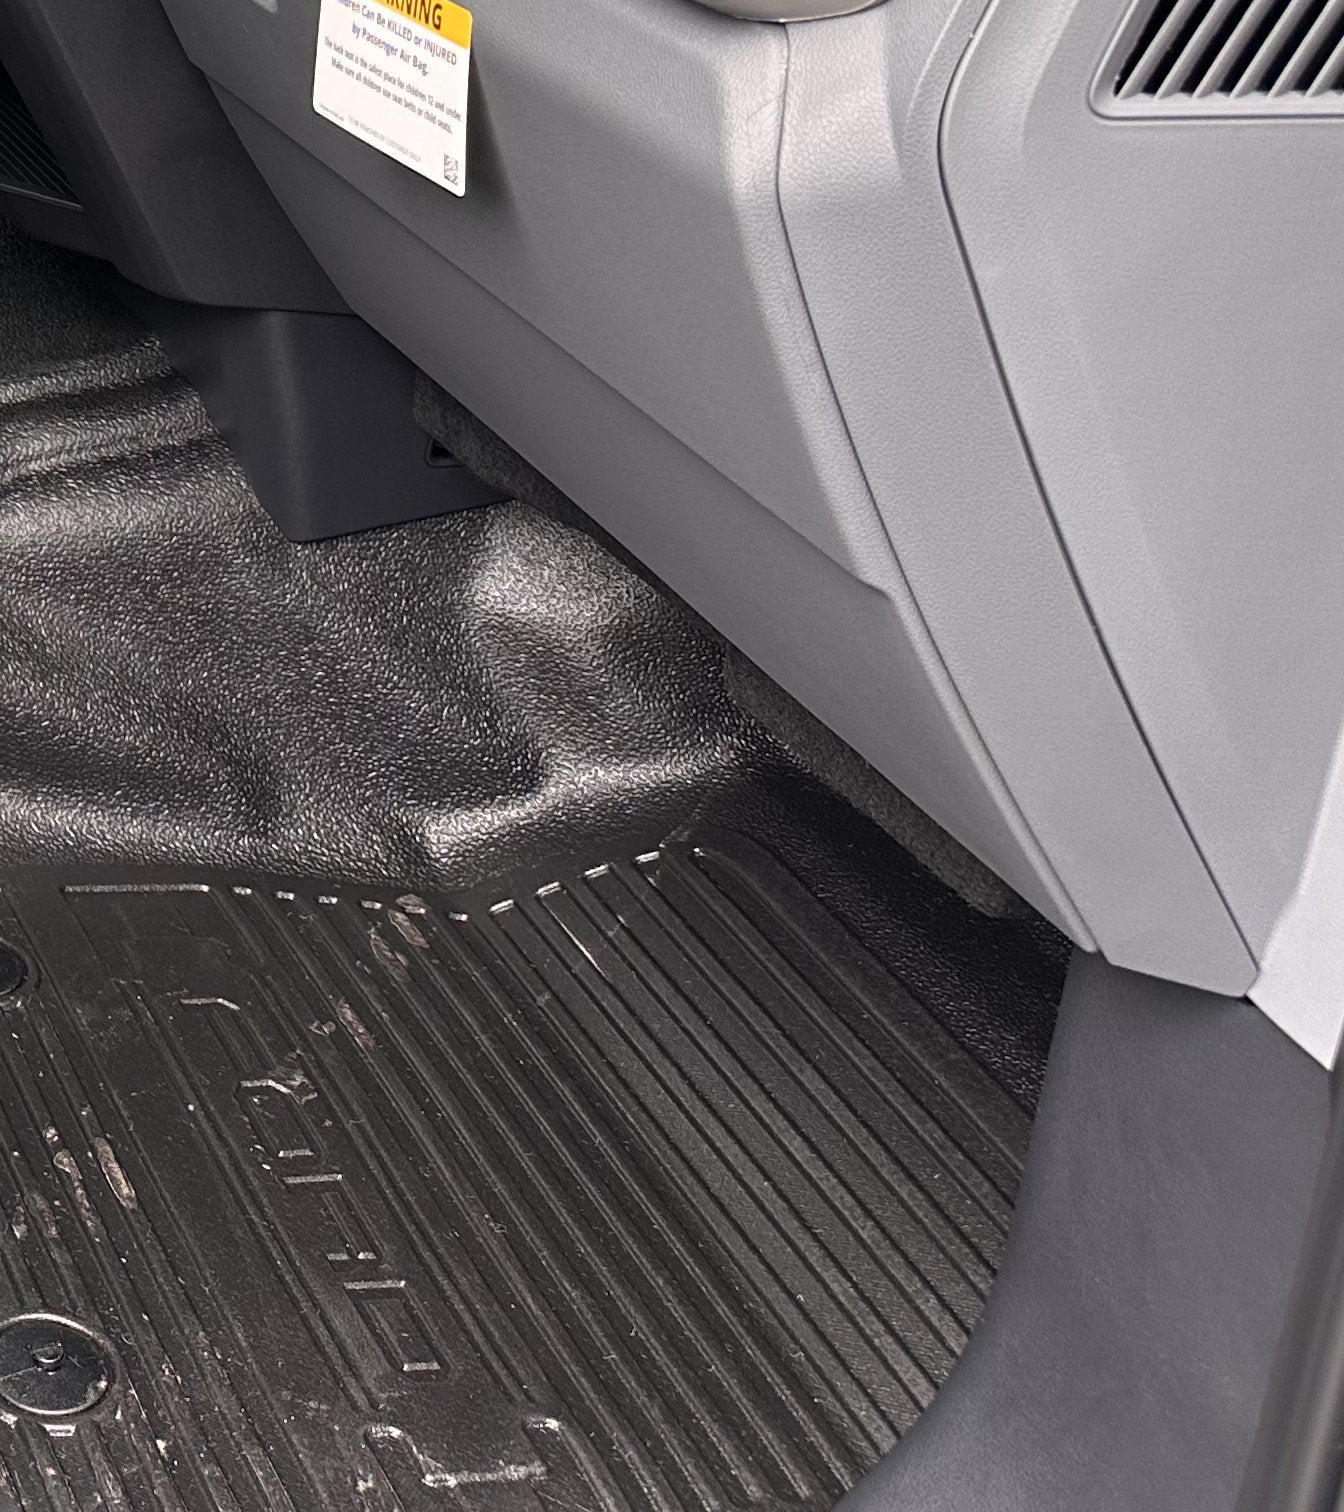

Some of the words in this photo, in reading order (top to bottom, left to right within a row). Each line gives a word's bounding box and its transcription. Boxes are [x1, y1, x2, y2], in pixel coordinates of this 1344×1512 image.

[352, 21, 360, 39] by
[362, 27, 399, 57] Passenger
[399, 49, 411, 65] Air
[362, 4, 375, 22] Can
[376, 12, 386, 28] Be
[387, 17, 412, 42] KILLED
[413, 35, 423, 47] or
[424, 38, 458, 66] INJURED
